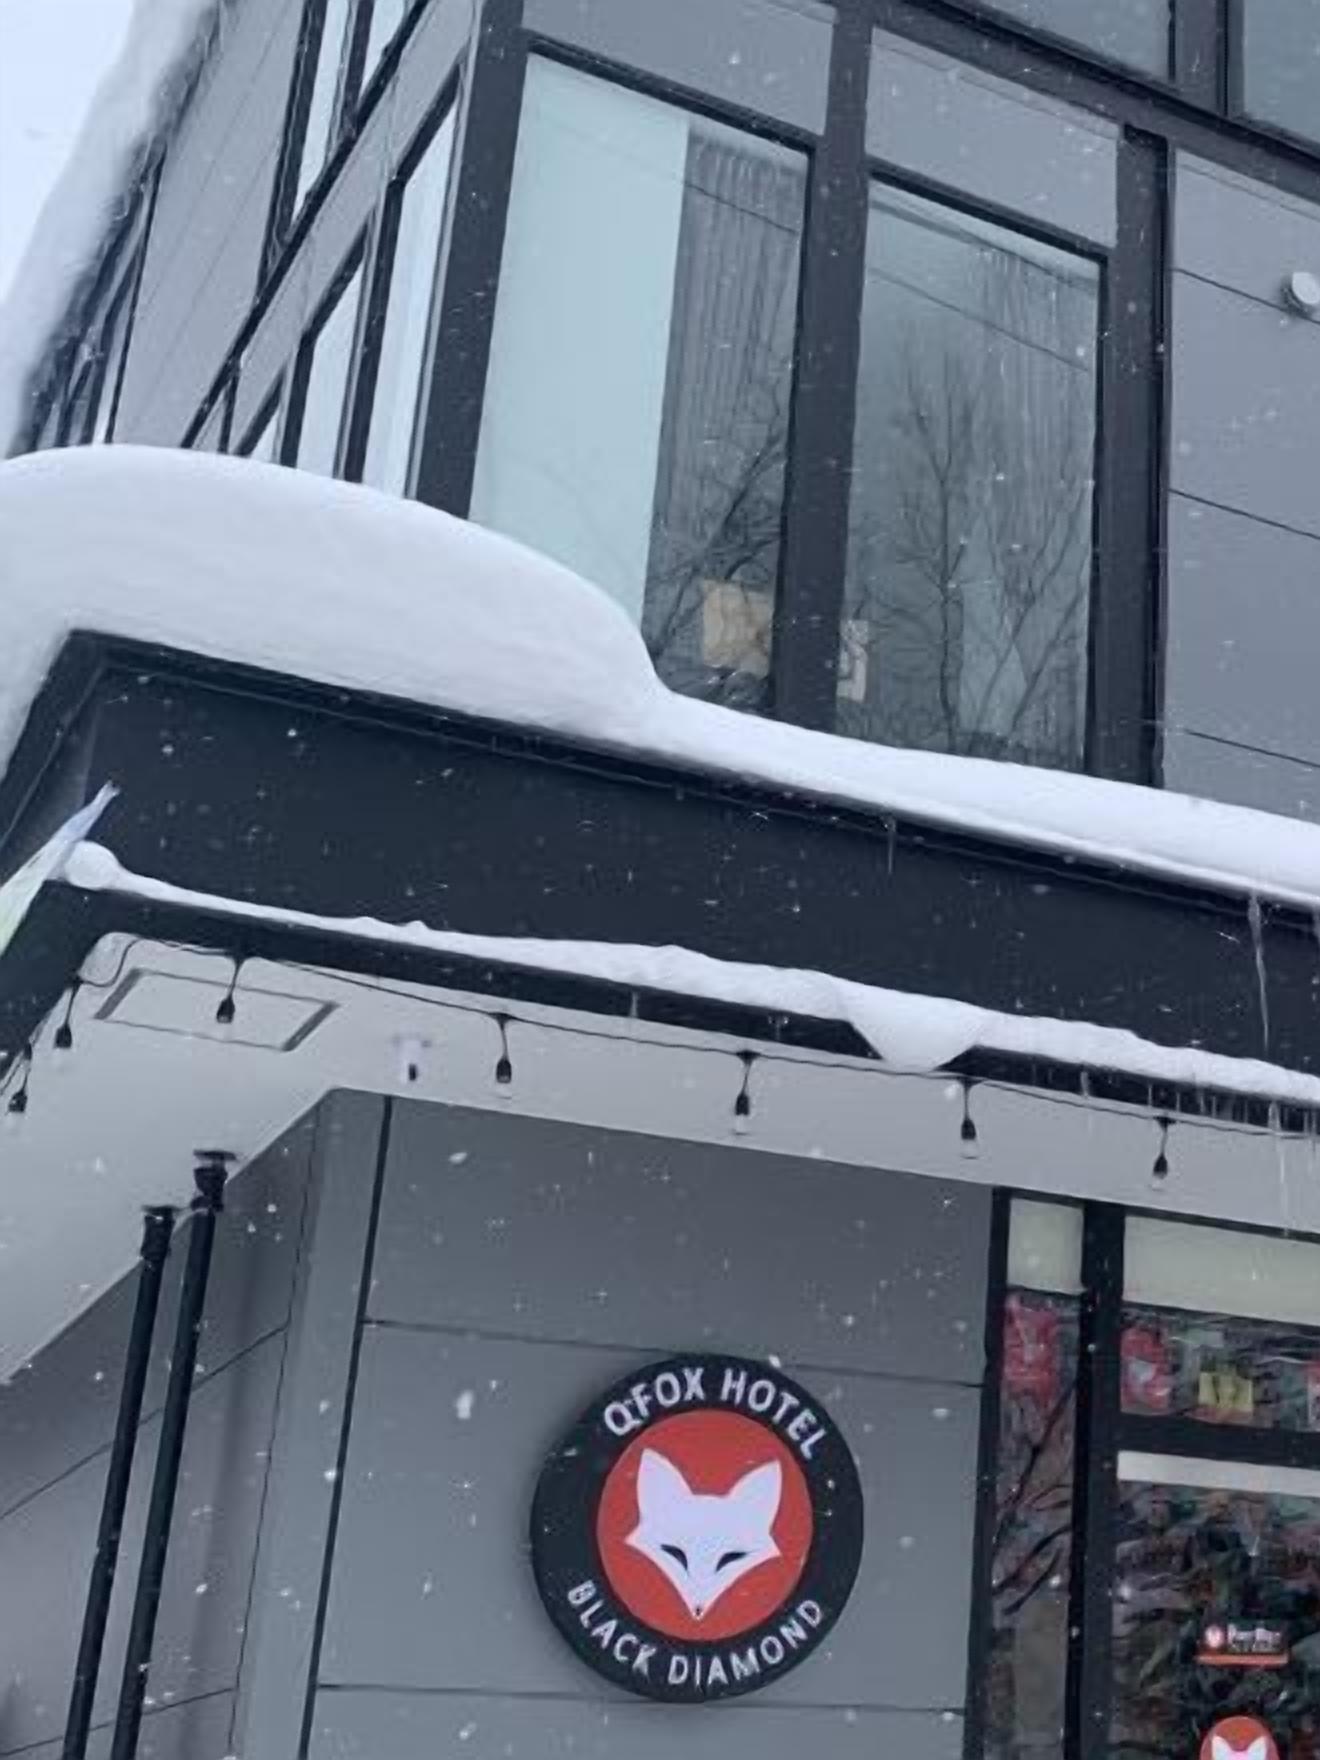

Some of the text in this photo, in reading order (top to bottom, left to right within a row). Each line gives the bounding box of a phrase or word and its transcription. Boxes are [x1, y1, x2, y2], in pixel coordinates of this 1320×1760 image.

[603, 1367, 829, 1460] QFOX HOTEL
[567, 1579, 824, 1687] BLACK DIAMOND
